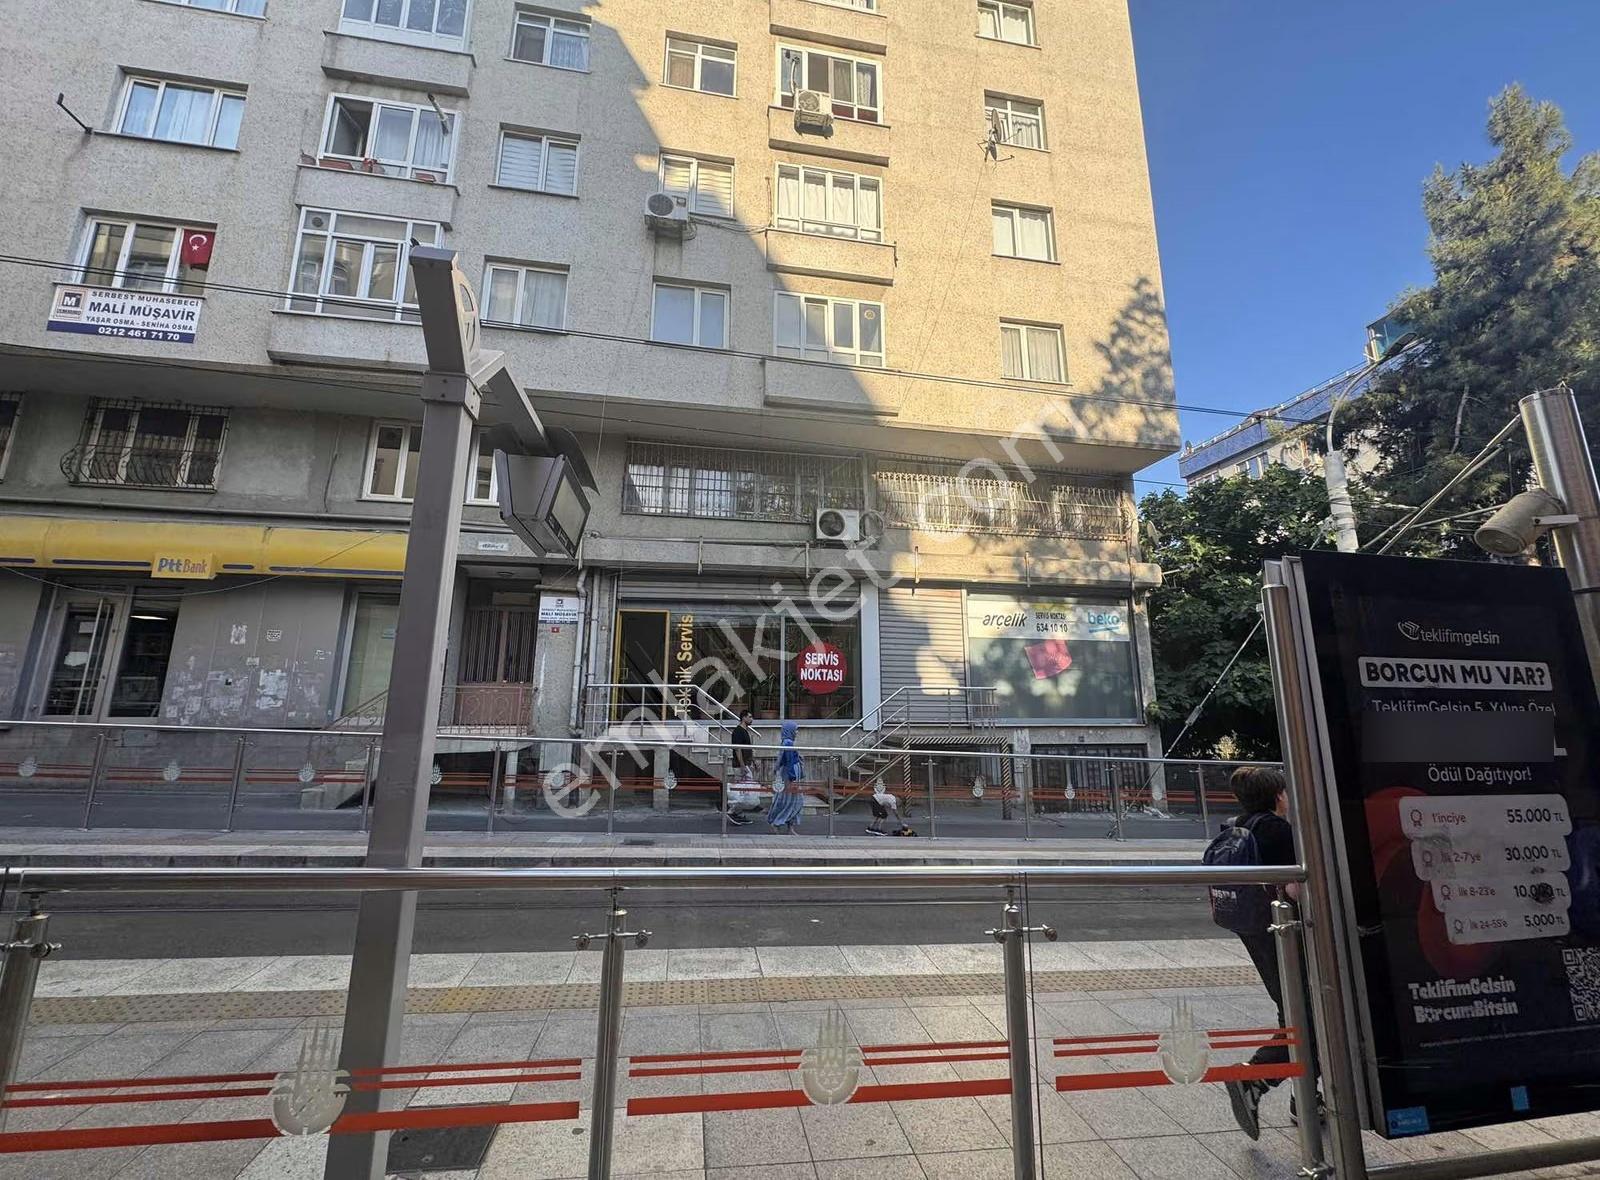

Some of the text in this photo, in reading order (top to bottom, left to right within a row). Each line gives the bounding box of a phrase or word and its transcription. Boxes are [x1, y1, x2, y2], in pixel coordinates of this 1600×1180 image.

[92, 290, 136, 300] SERBEST
[89, 301, 125, 315] MALİ
[130, 304, 196, 321] MÜŞAVİR
[113, 318, 135, 326] OSMA
[171, 323, 194, 332] OSMA
[98, 326, 180, 341] 0212 461 71 70
[982, 612, 1120, 630] arçelik beko
[1036, 623, 1048, 633] 634
[676, 614, 693, 662] Servis
[1420, 628, 1500, 646] teklifimgelsin
[804, 650, 839, 666] SERVİS
[800, 668, 843, 682] NOKTASI
[1365, 661, 1546, 686] BORCUN MU VAR?
[1428, 763, 1532, 785] Ödül Dağıtıyor!
[1507, 808, 1551, 823] 55.000
[1505, 845, 1549, 861] 30.000
[1524, 914, 1555, 927] 5.000
[1408, 975, 1516, 1000] TeklifimGelsin
[1413, 997, 1519, 1024] BorcumBitsin
